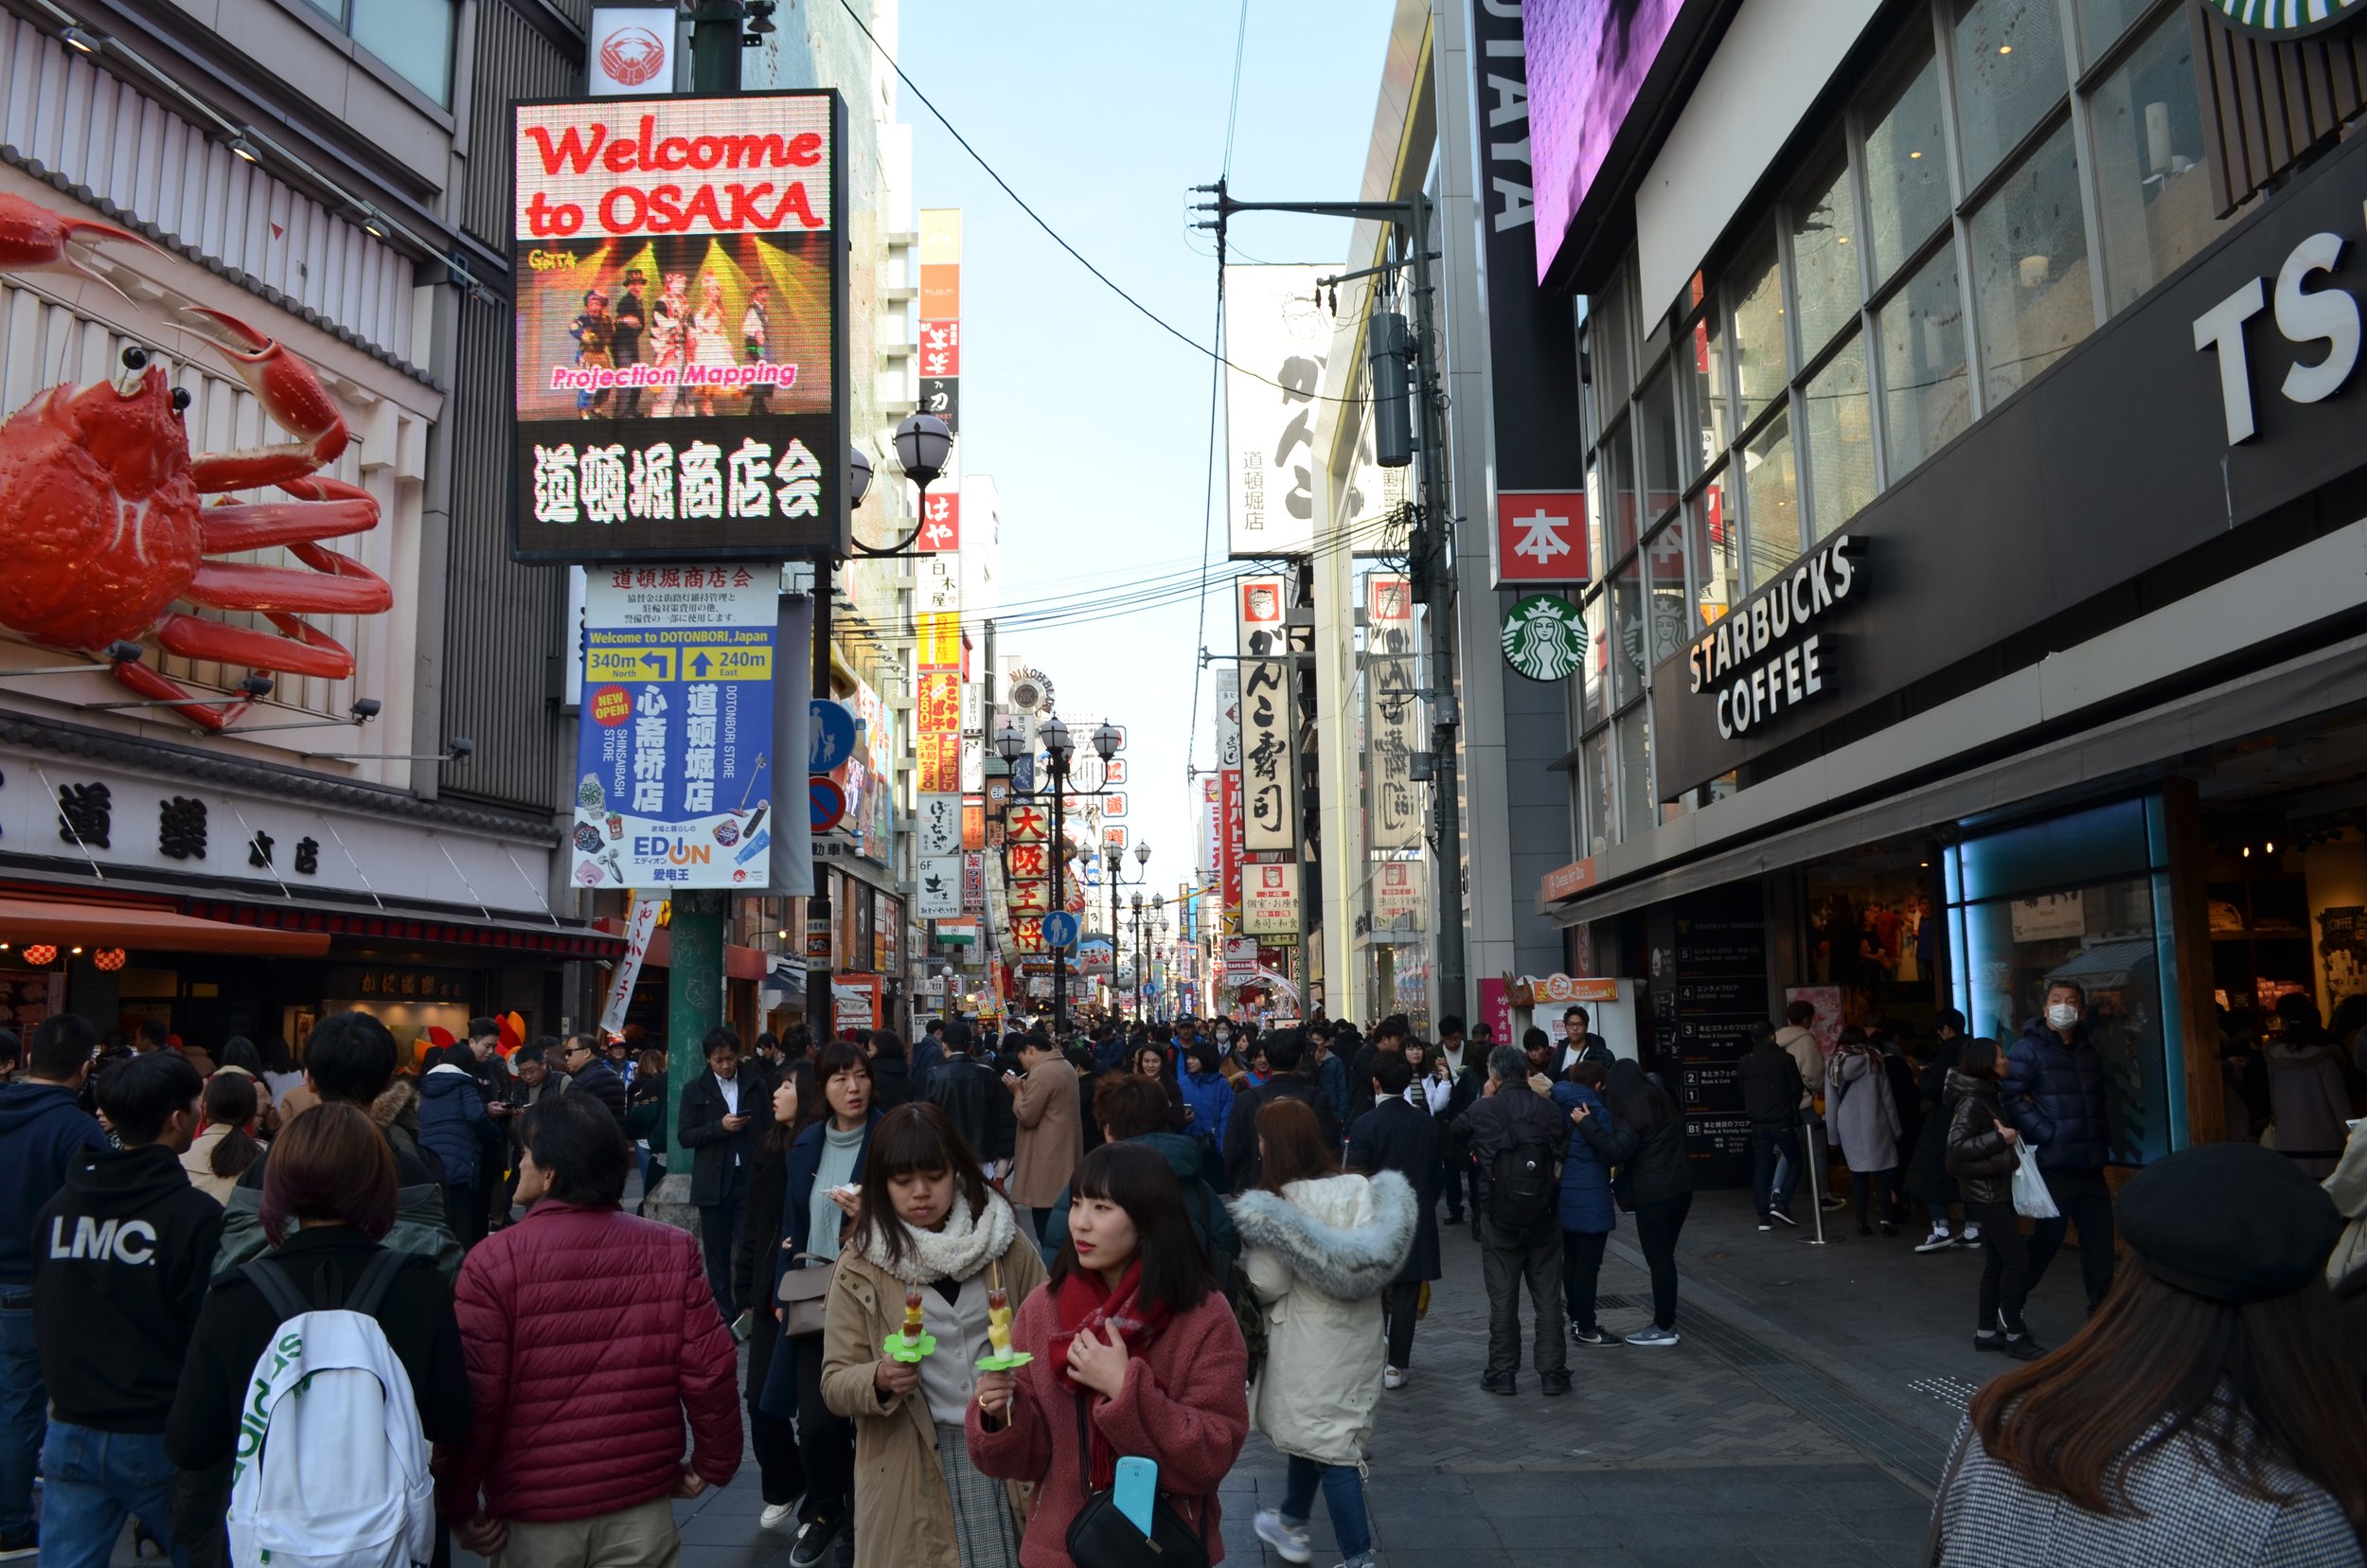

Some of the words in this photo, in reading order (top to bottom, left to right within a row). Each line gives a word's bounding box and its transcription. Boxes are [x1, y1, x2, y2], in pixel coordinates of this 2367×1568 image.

[1484, 0, 1534, 233] TAYA
[525, 116, 822, 175] Welcome
[525, 192, 584, 237] to
[598, 182, 825, 235] OSAKA
[2193, 201, 2367, 446] TS
[550, 364, 676, 391] Projection
[684, 361, 798, 388] Mapping
[534, 437, 822, 523] 道頓堀商店会
[1244, 451, 1264, 531] 道頓堀店
[1513, 508, 1571, 563] 本
[612, 566, 754, 589] 道頓堀商店会
[1690, 535, 1854, 694] STARBUCKS
[590, 632, 641, 644] Welcome
[645, 633, 656, 644] to
[734, 632, 768, 645] Japan
[591, 653, 636, 668] 340m
[720, 651, 765, 667] 240m
[613, 669, 636, 678] North
[720, 668, 738, 677] East
[598, 692, 624, 706] NEW
[1717, 634, 1822, 739] COFFEE
[596, 704, 629, 720] OPEN!
[725, 686, 738, 743] DOTONBORI
[603, 729, 615, 762] STORE
[614, 729, 628, 796] SHINSAIBASHI
[723, 746, 736, 778] STORE
[650, 825, 696, 833] 家電と暮らしの
[634, 836, 711, 864] EDION
[920, 861, 932, 870] 6F
[1007, 806, 1046, 953] 大阪王将
[1682, 951, 1688, 959] 5
[1683, 989, 1690, 997] 4
[1685, 1025, 1692, 1035] 3
[1688, 1074, 1694, 1082] 2
[1689, 1091, 1694, 1100] 1
[1688, 1125, 1699, 1133] B1
